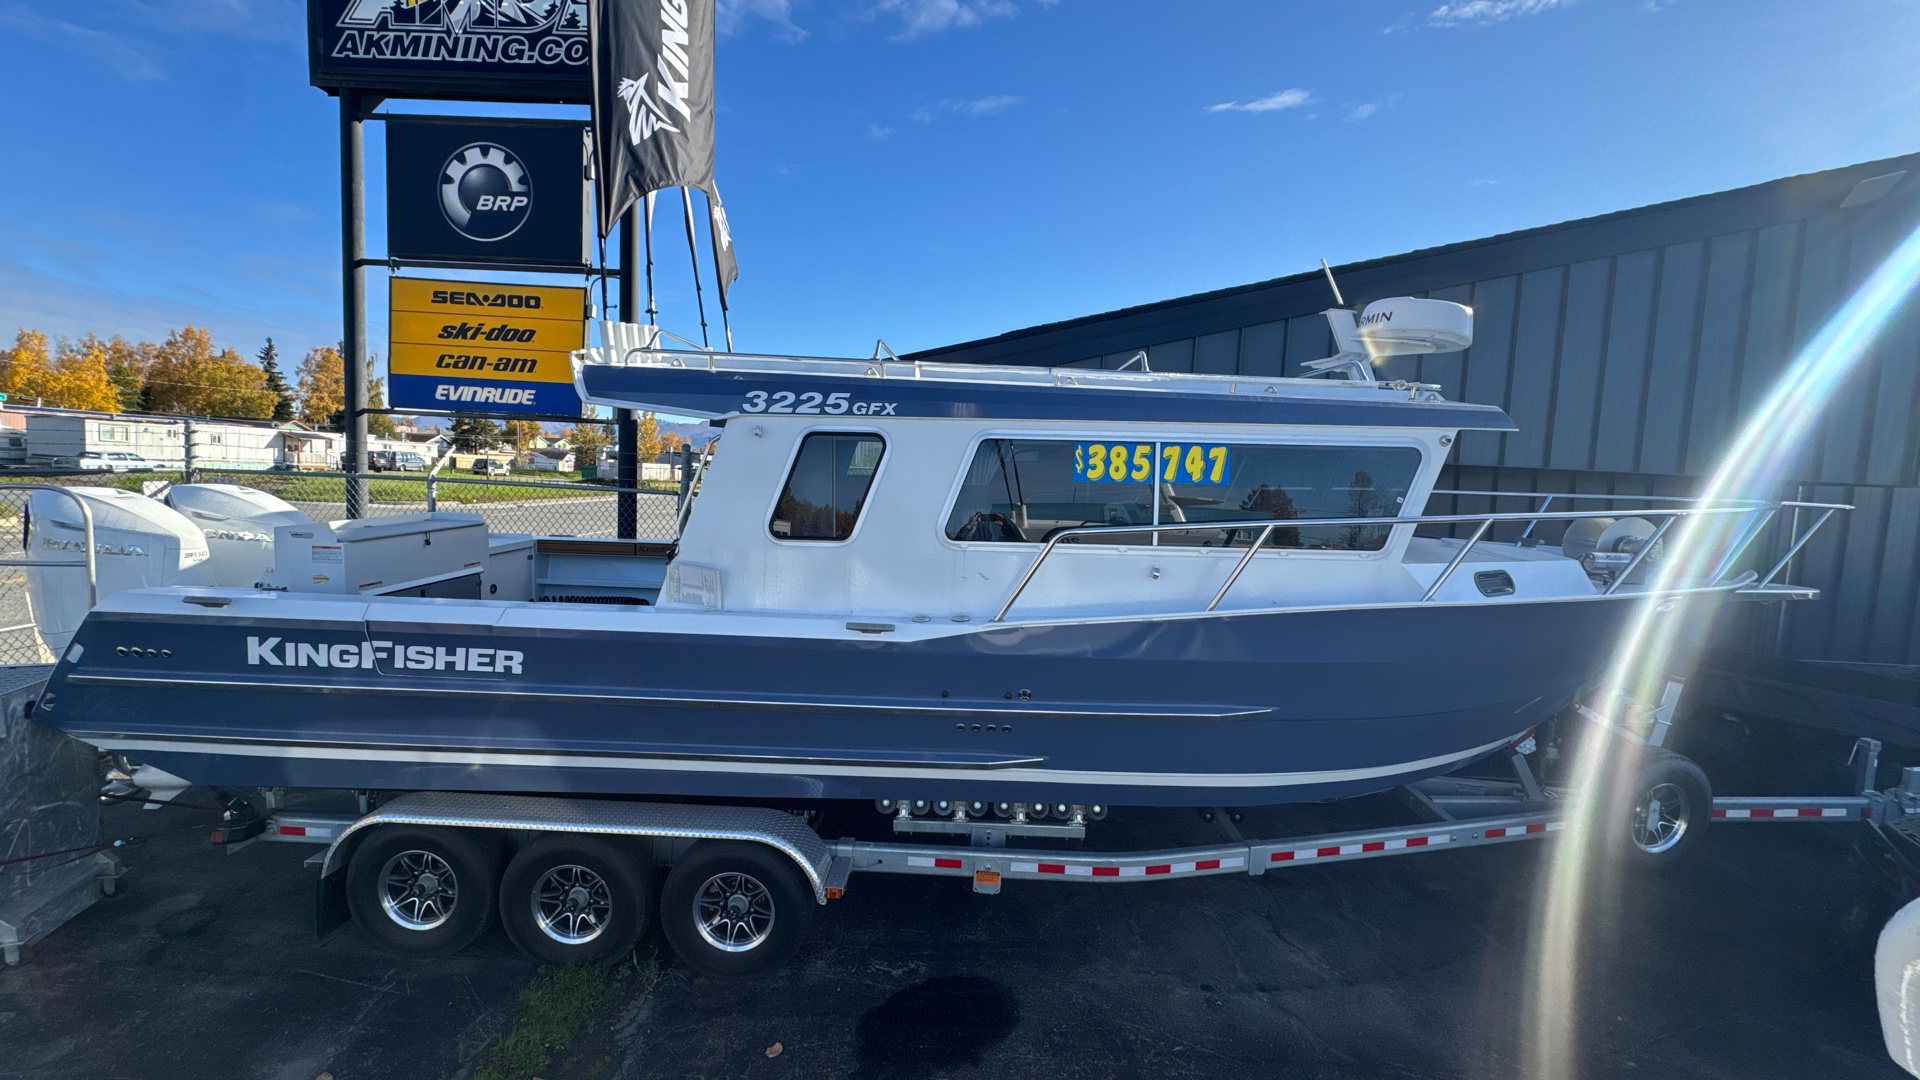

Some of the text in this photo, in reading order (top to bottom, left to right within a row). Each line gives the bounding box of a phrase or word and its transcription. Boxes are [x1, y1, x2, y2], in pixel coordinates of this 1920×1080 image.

[331, 30, 588, 65] AKMINING.CO
[476, 195, 528, 211] BRP
[1360, 311, 1393, 326] RMIN
[438, 322, 537, 343] ski-doo
[436, 354, 537, 373] can-am
[435, 384, 536, 405] EVINRUDE
[742, 390, 899, 416] 3225 GFX
[203, 528, 273, 542] ONDA
[247, 636, 524, 674] KINGFISHER
